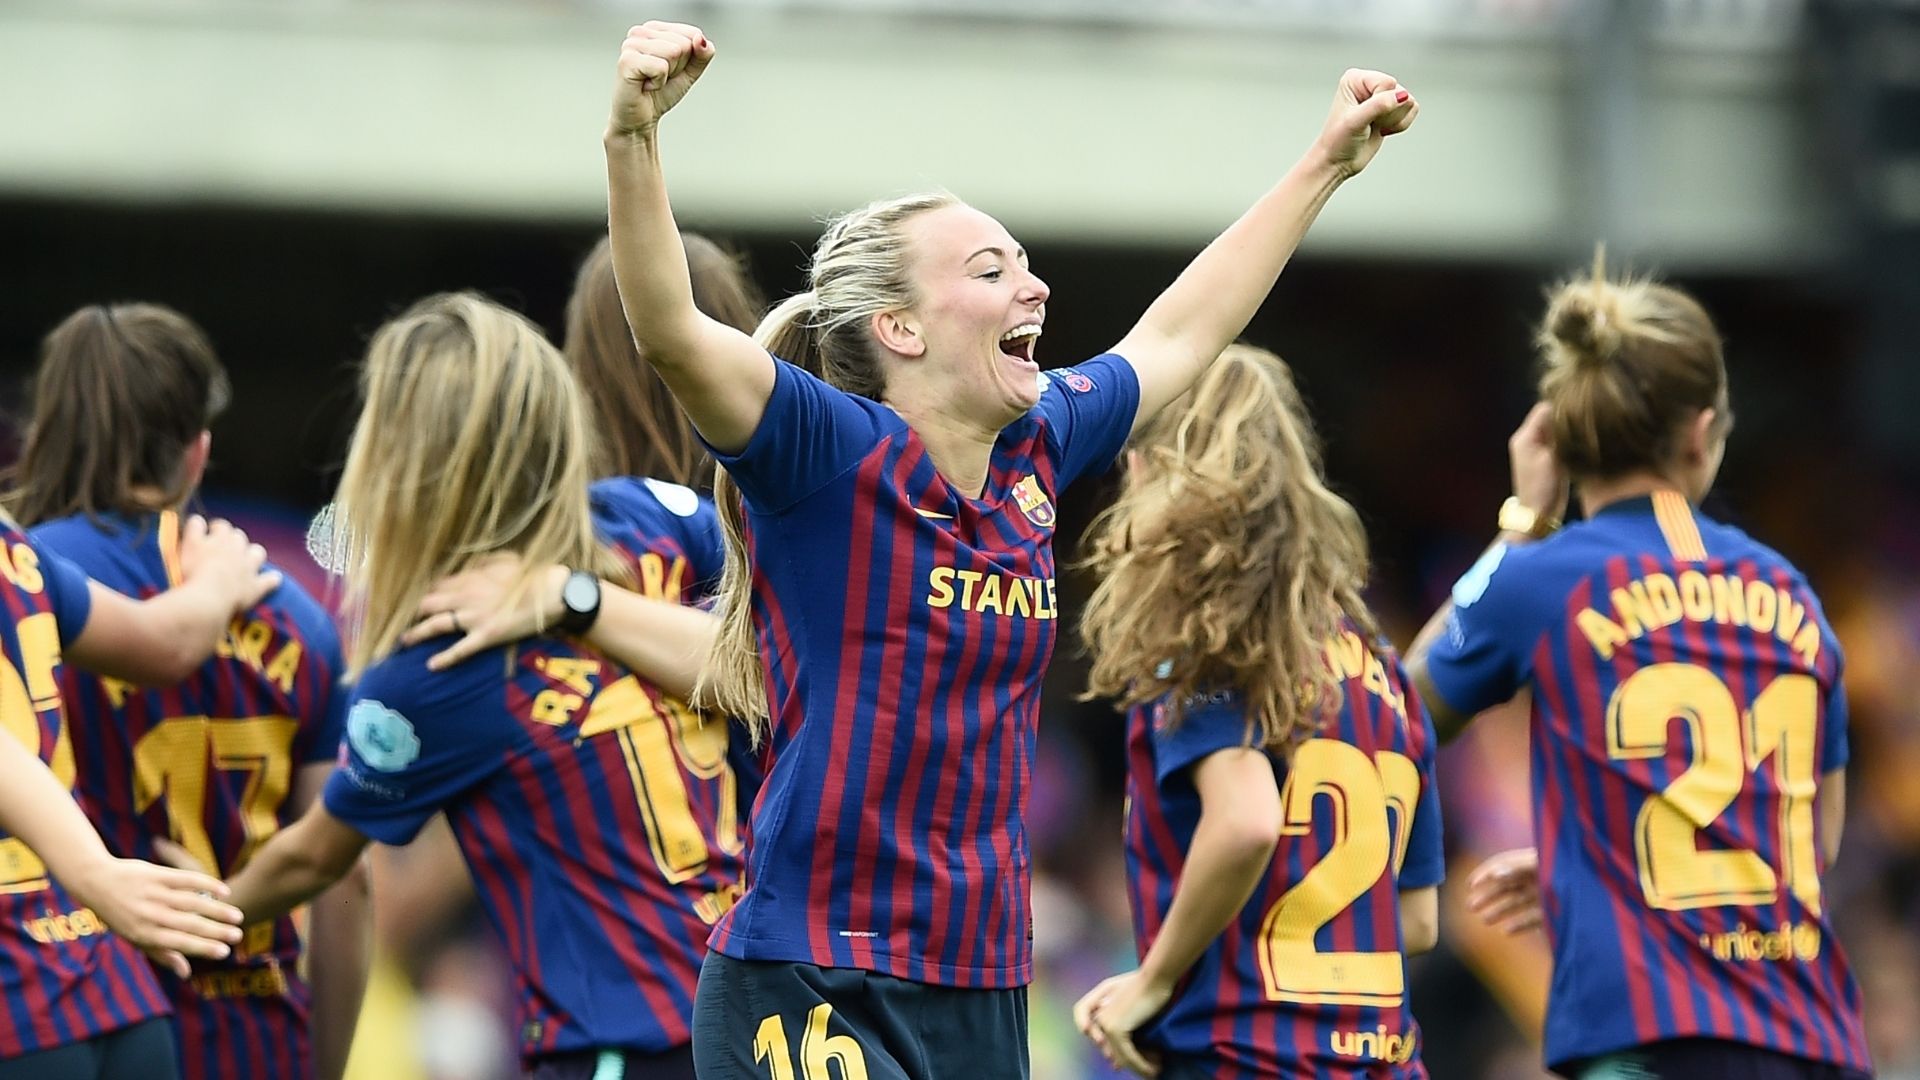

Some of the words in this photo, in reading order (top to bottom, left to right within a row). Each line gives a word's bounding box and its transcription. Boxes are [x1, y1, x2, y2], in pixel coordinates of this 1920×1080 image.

[927, 566, 1058, 619] STANLE
[1577, 570, 1820, 668] ANDONOVA
[132, 714, 298, 960] 17
[1606, 662, 1822, 918] 21
[753, 1002, 869, 1080] 16
